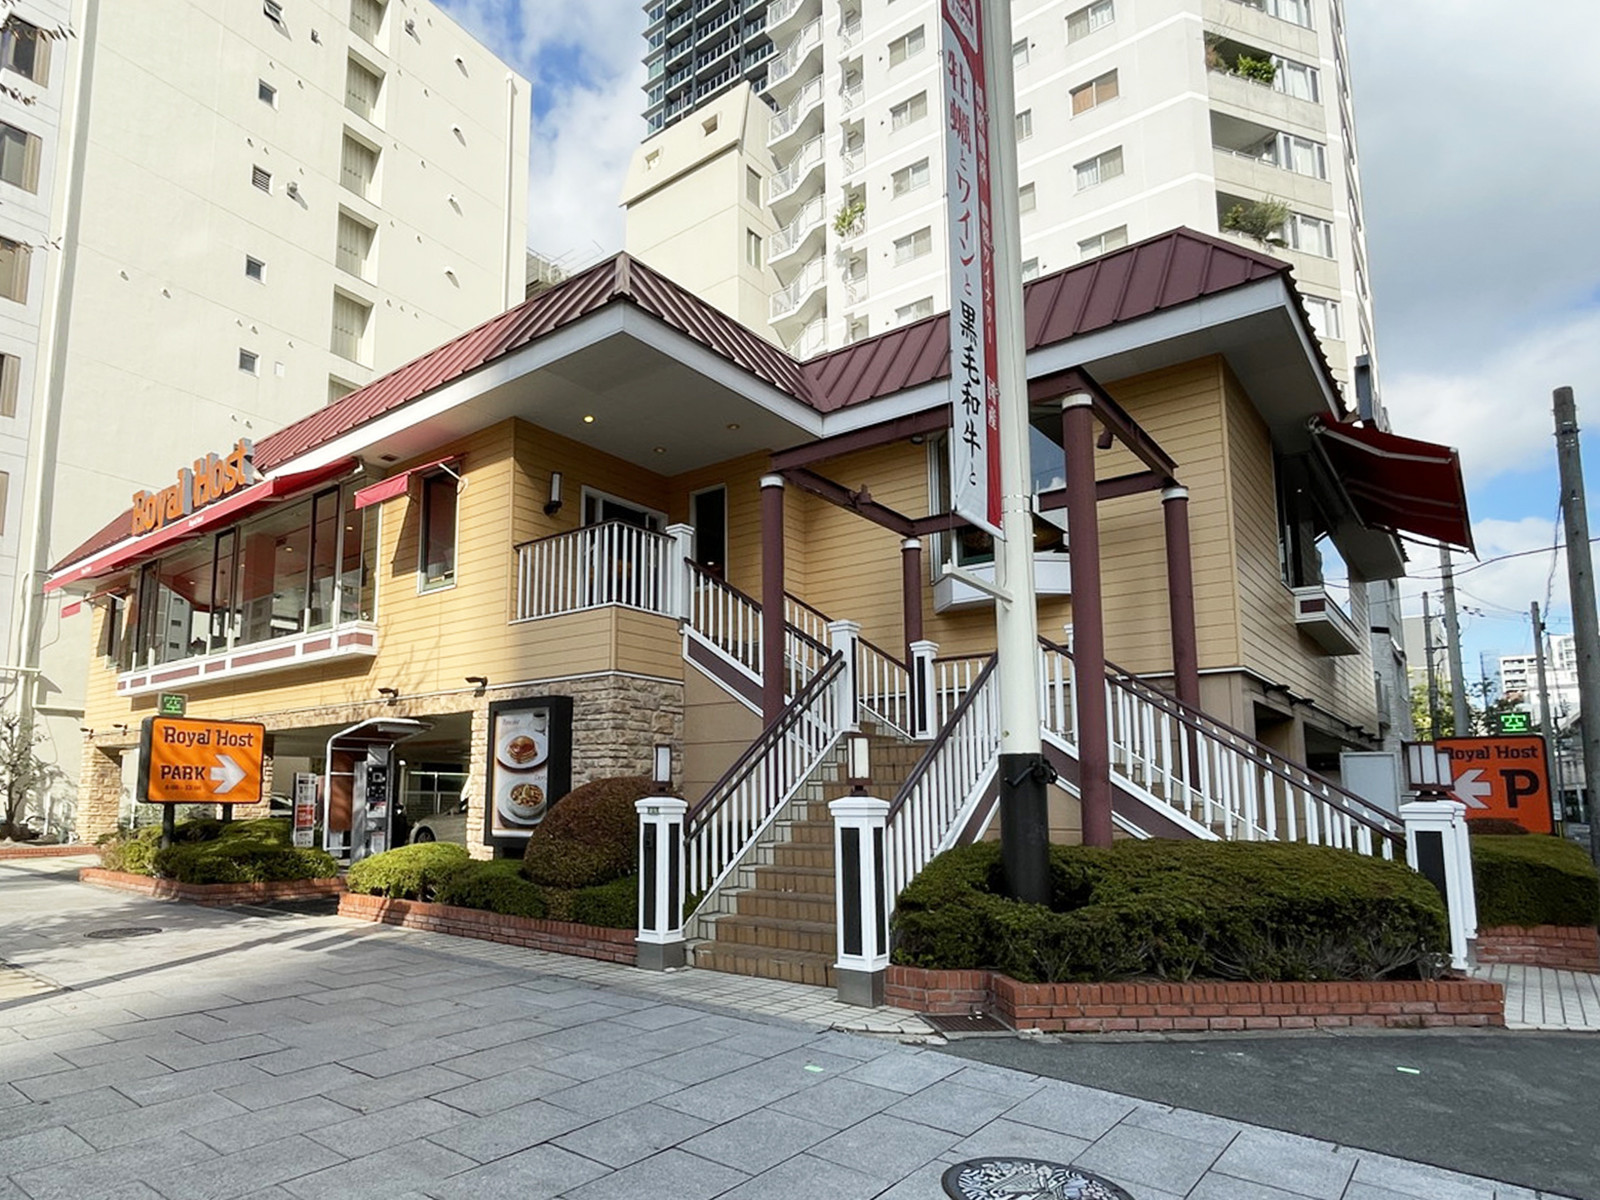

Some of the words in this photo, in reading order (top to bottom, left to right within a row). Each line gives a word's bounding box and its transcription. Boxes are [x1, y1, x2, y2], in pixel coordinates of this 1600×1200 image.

[132, 467, 191, 536] Royal
[193, 437, 254, 508] Host
[1500, 713, 1527, 732] 空
[163, 726, 211, 748] Royal
[216, 728, 254, 748] Host
[1494, 745, 1538, 759] Host
[160, 765, 206, 780] PARK
[1500, 768, 1540, 809] P
